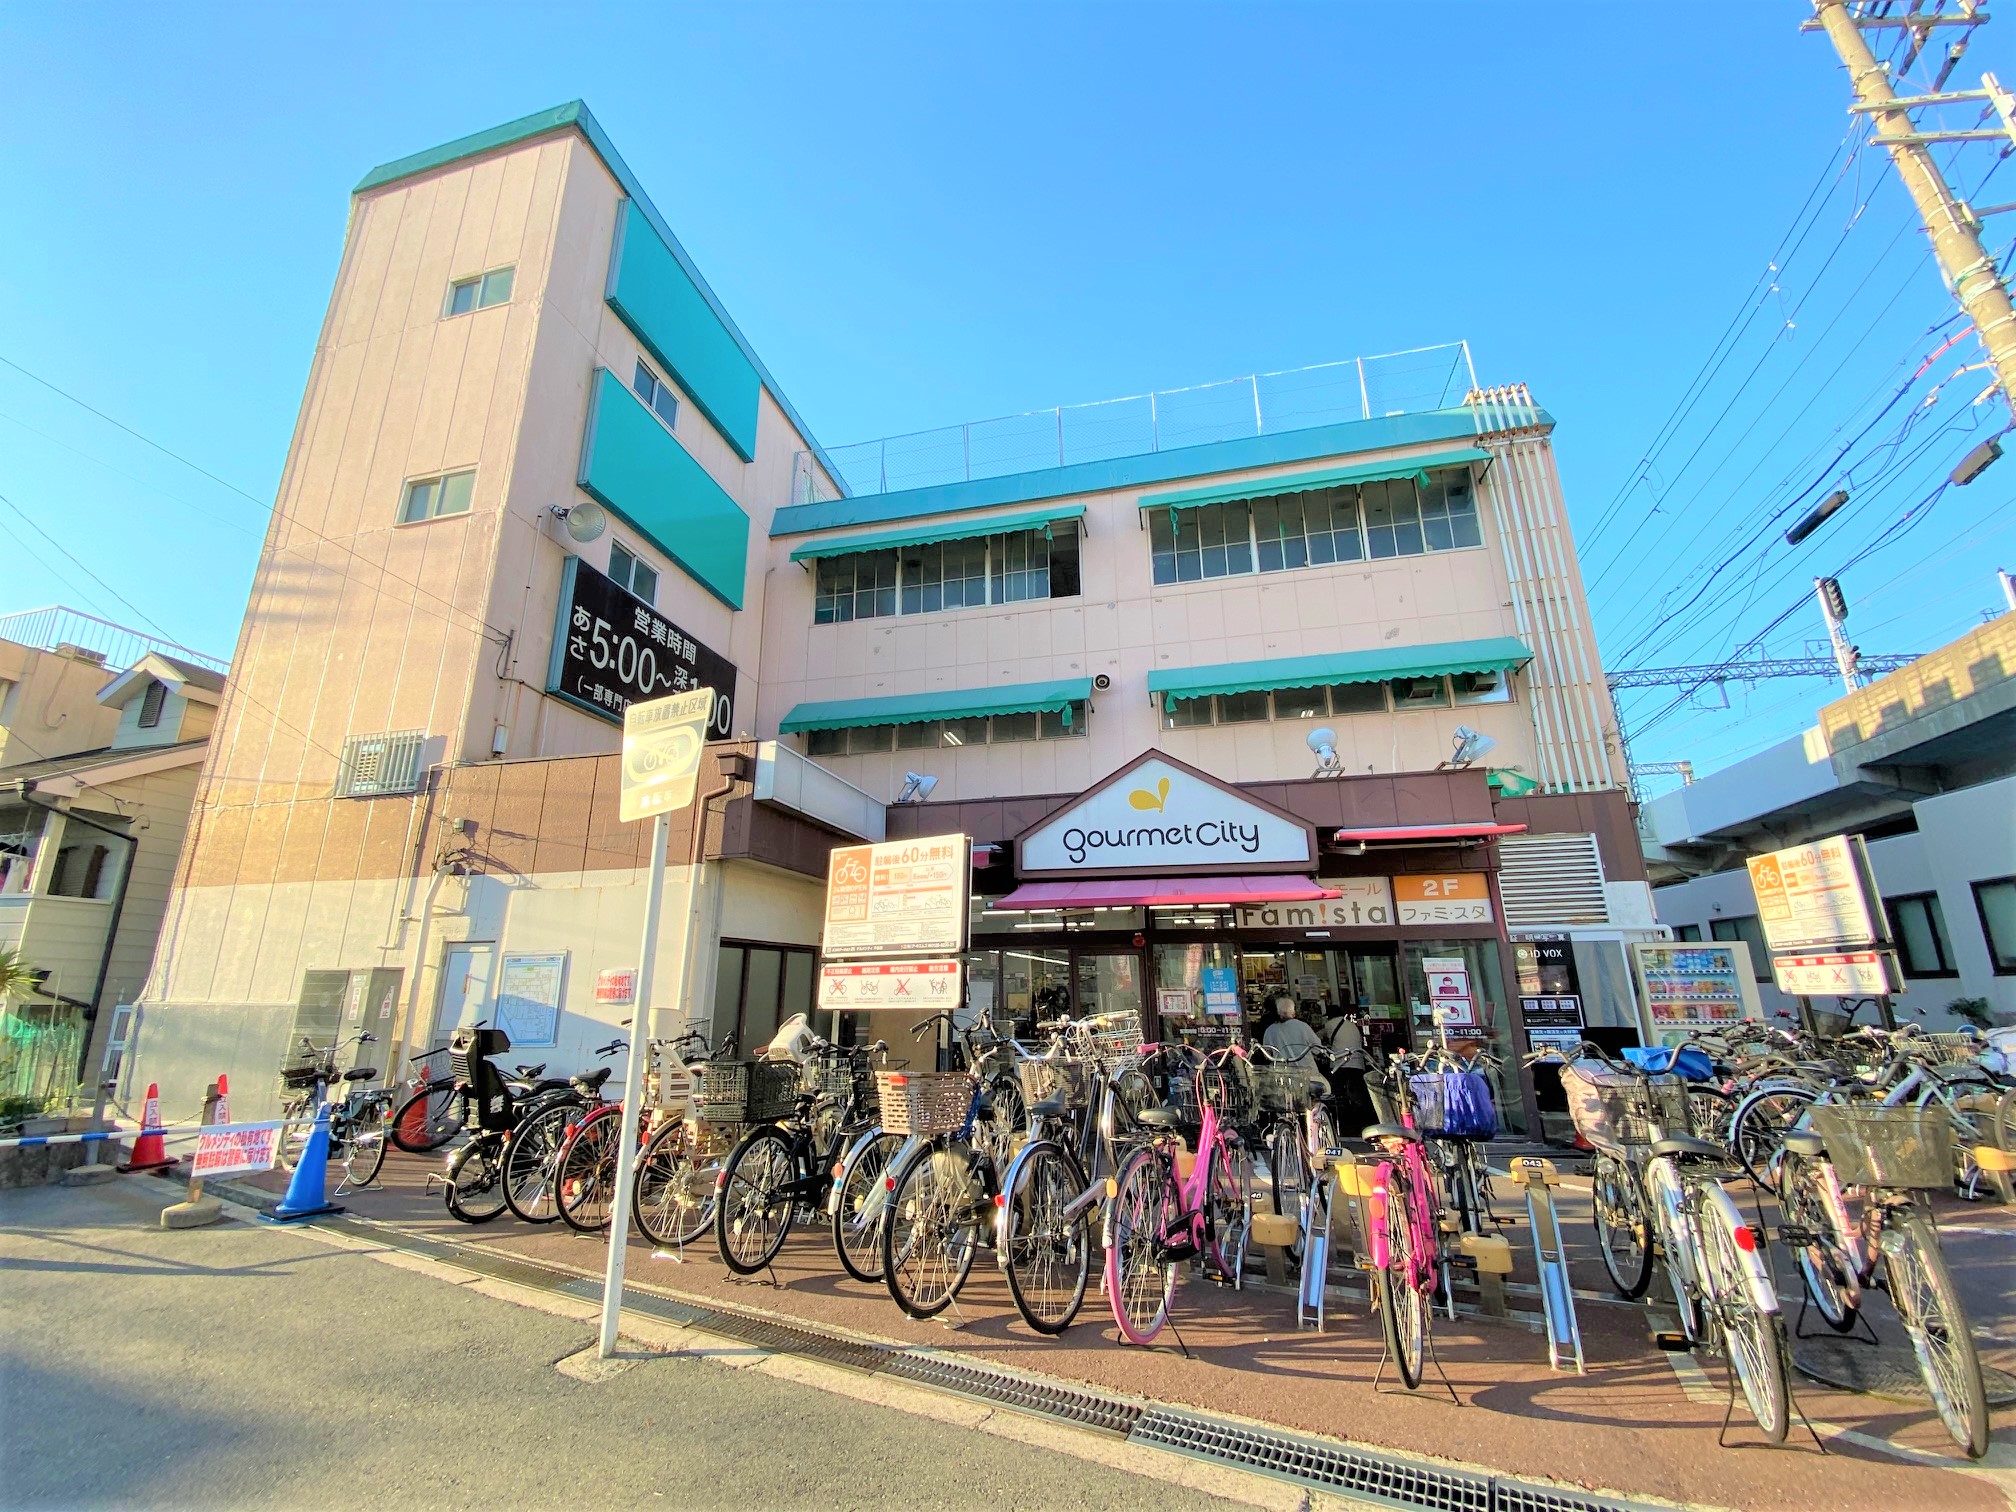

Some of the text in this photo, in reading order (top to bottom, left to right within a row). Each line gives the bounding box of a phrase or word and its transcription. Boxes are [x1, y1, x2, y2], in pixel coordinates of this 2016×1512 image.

[570, 605, 592, 661] あさ
[634, 606, 697, 666] 営業時間
[874, 845, 954, 866] 駐輪後60分無料
[1422, 878, 1459, 896] 2F
[1542, 949, 1563, 958] VOX
[1325, 1148, 1341, 1156] 041
[1522, 1159, 1543, 1167] 043
